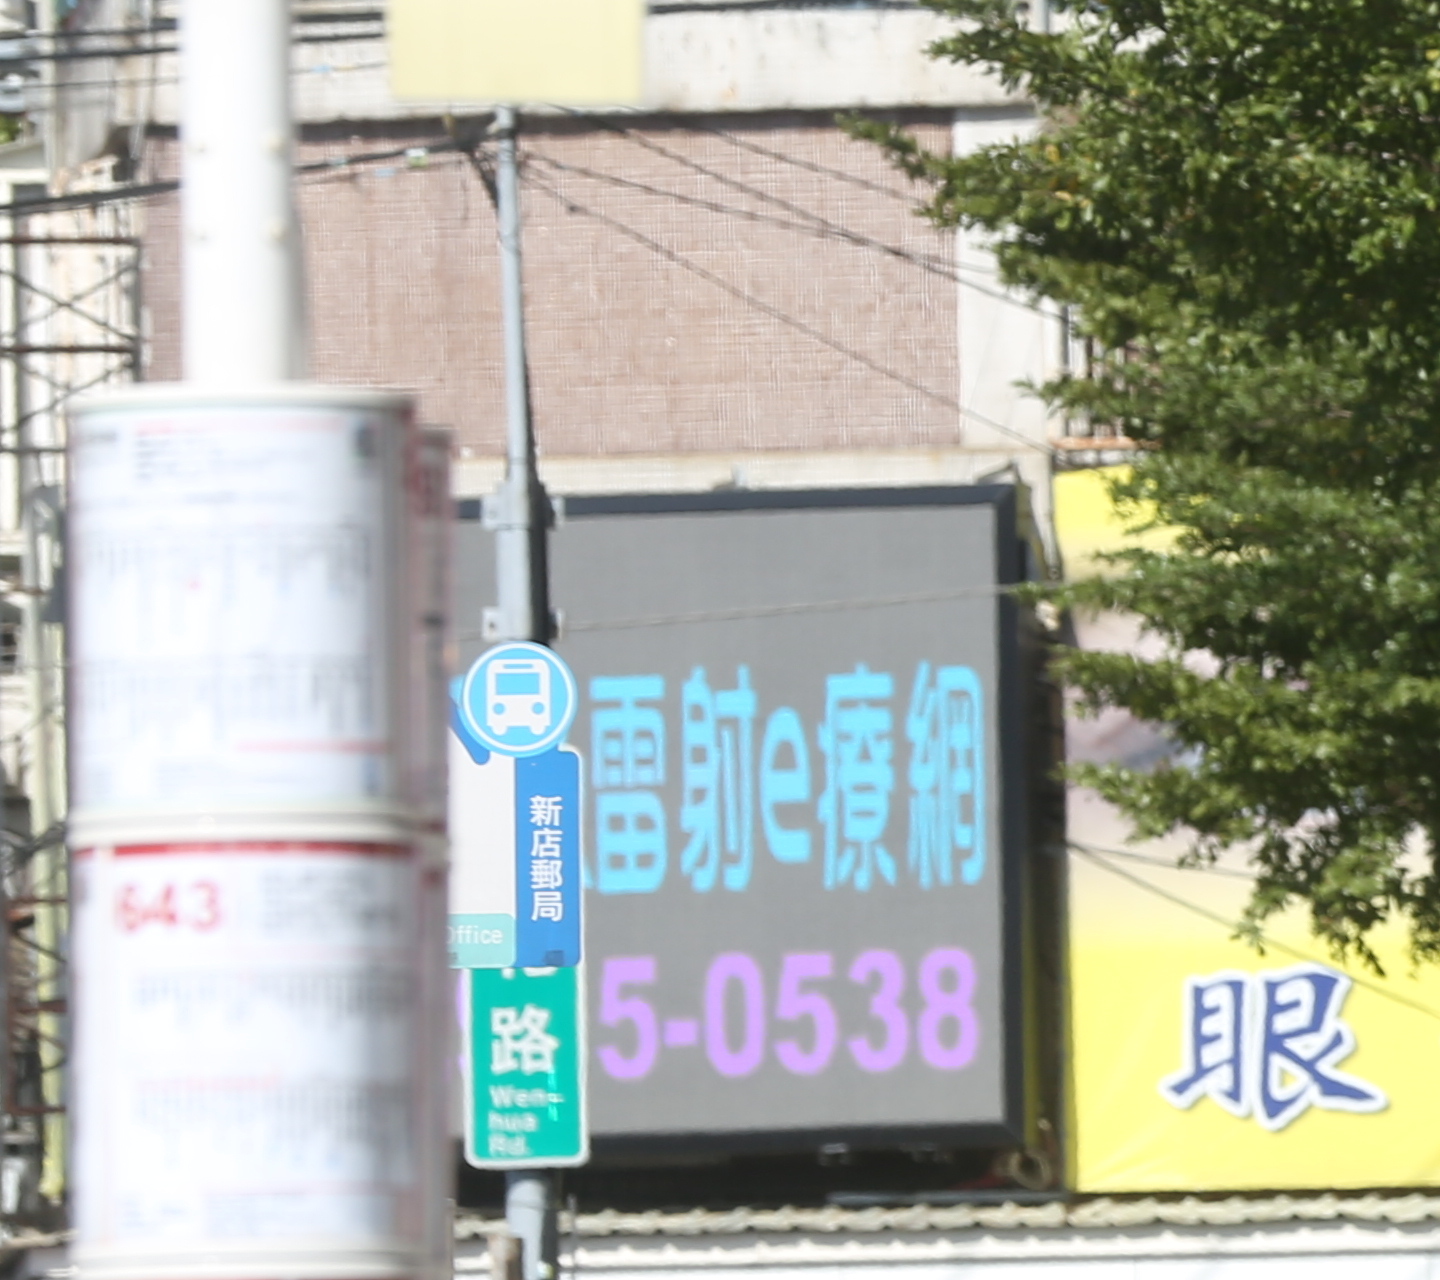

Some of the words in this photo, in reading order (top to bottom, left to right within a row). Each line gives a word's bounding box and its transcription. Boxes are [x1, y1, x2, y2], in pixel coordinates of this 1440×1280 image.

[584, 661, 986, 894] 雷射e療網
[115, 879, 223, 934] 643
[529, 794, 565, 923] 新店郵局
[489, 970, 561, 1076] 路
[597, 946, 979, 1080] 5-0538
